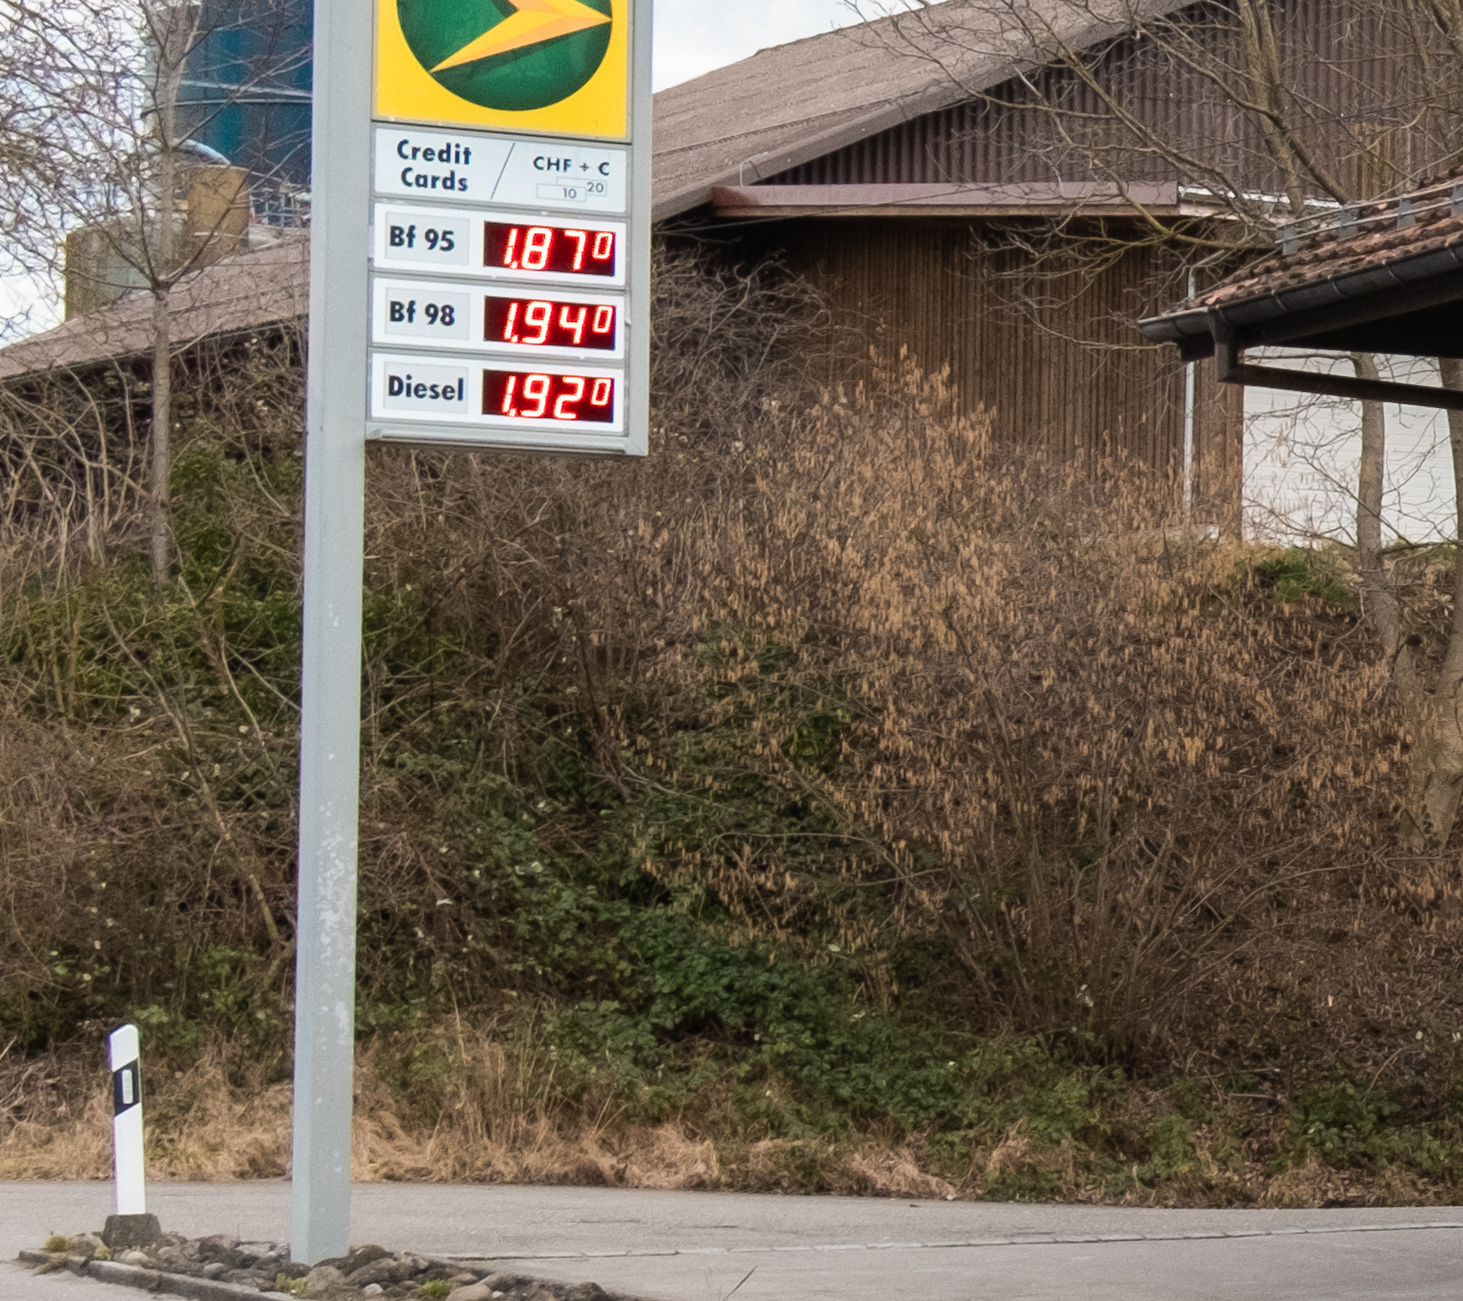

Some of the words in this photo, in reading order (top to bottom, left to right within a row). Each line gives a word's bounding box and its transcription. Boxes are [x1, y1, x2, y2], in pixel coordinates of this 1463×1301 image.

[397, 139, 472, 165] Credit
[533, 156, 572, 173] CHF
[401, 167, 469, 192] Cards
[587, 181, 604, 195] 20
[563, 186, 577, 199] 10
[389, 225, 417, 249] Bf
[425, 229, 455, 251] 95
[389, 300, 417, 324] Bf
[425, 303, 455, 326] 98
[388, 374, 464, 402] Diesel
